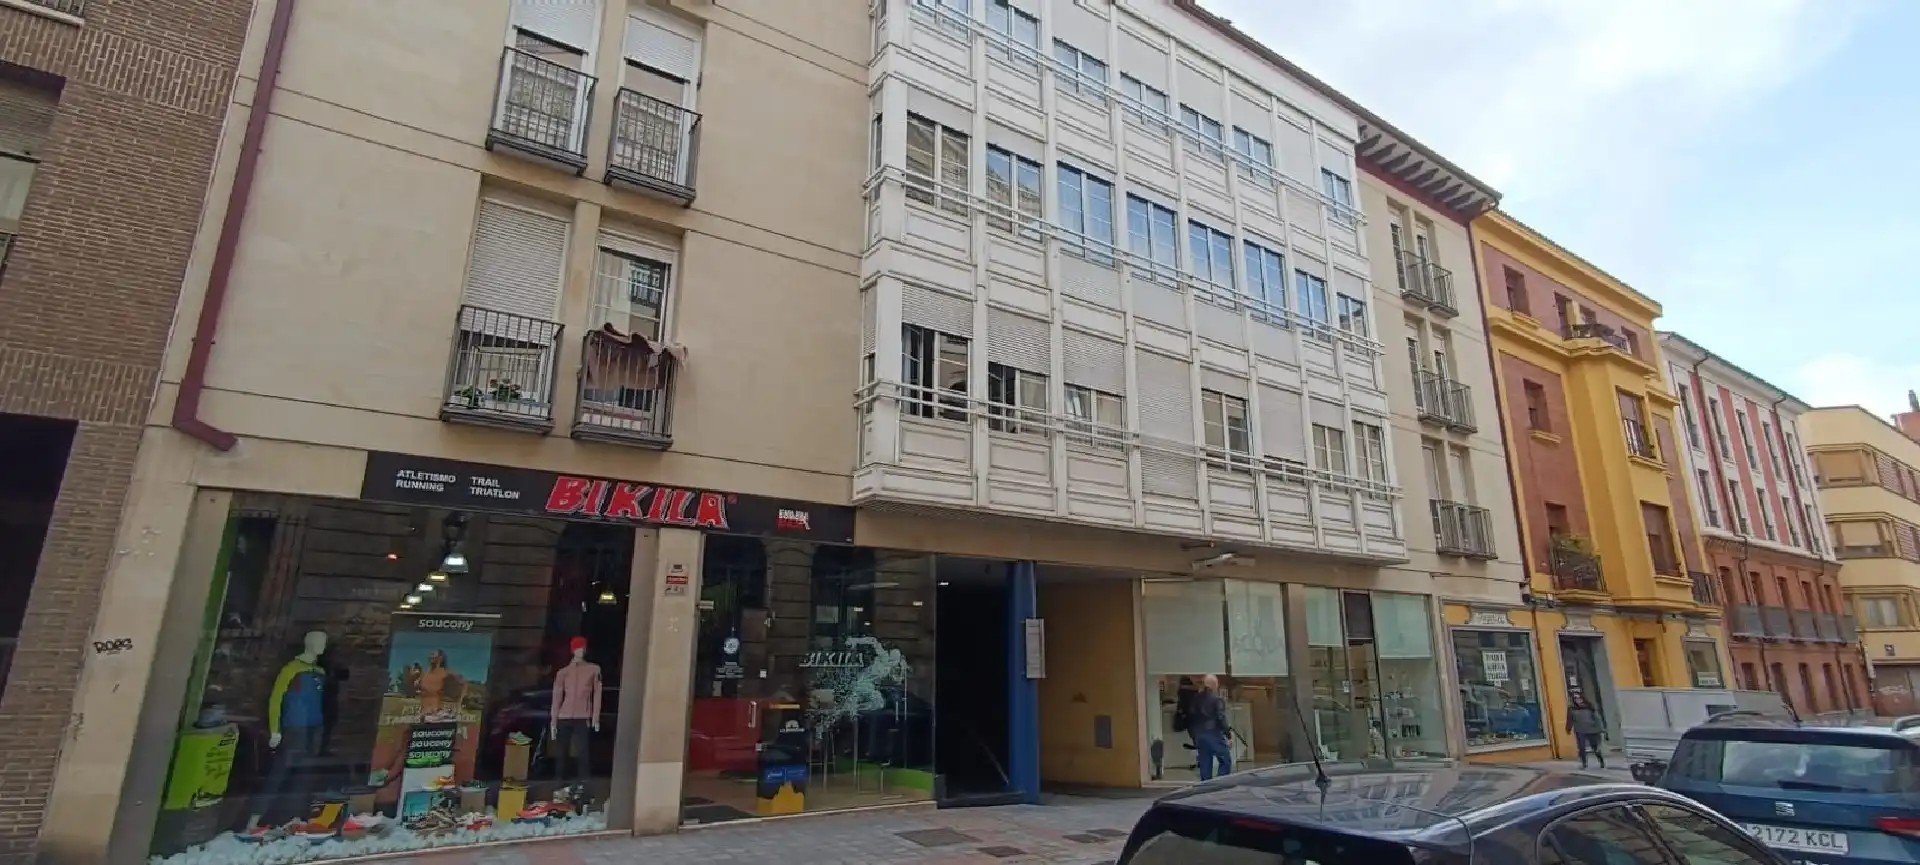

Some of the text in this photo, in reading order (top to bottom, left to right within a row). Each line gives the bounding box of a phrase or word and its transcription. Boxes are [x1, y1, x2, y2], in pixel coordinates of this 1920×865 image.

[396, 469, 456, 483] ATLETISMO
[471, 476, 500, 487] TRAIL
[395, 480, 444, 492] RUNNING
[470, 487, 519, 499] TRIATLON
[546, 476, 730, 530] BIKILA
[418, 619, 474, 631] saucony
[1751, 826, 1844, 848] 2172 KCL
